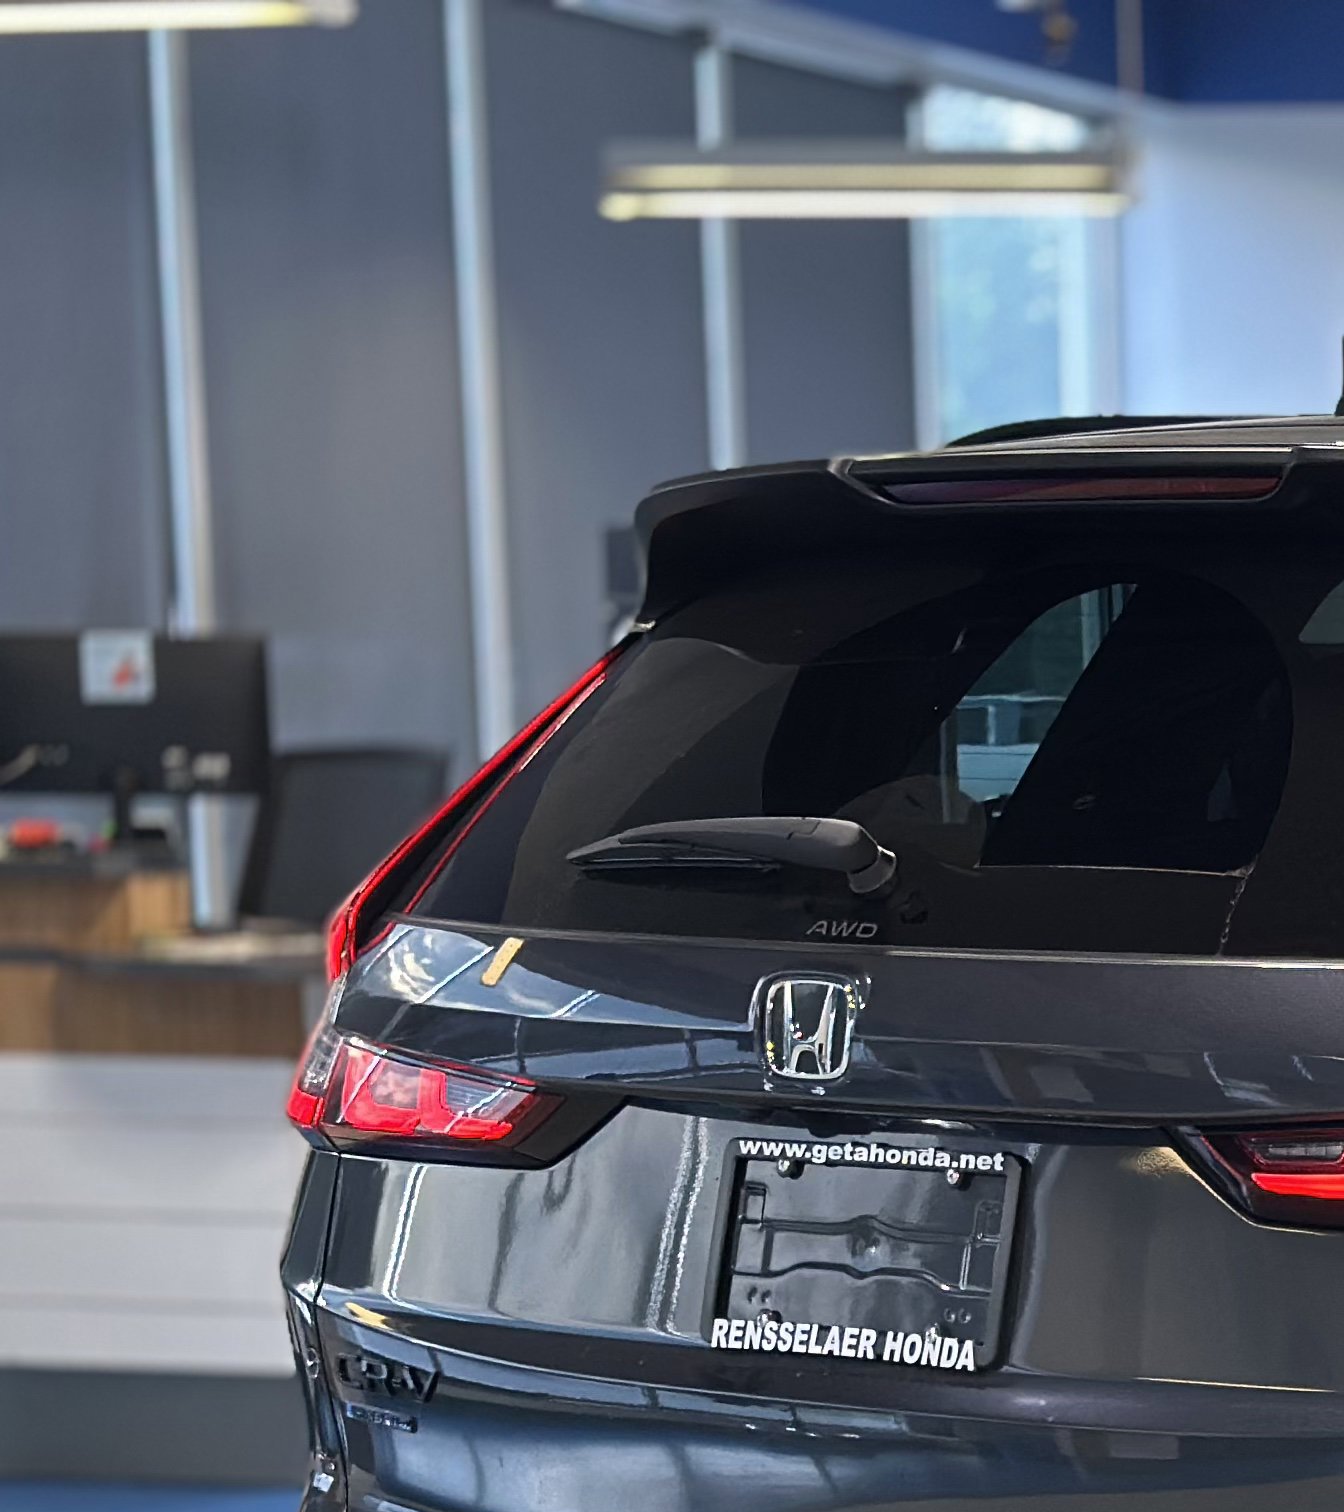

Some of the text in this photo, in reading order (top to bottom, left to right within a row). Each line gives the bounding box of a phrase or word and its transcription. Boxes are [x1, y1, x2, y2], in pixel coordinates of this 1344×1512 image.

[806, 920, 878, 938] AWD
[739, 1139, 1005, 1171] www.getahonda.net
[710, 1318, 976, 1372] RENSSELAER HONDA
